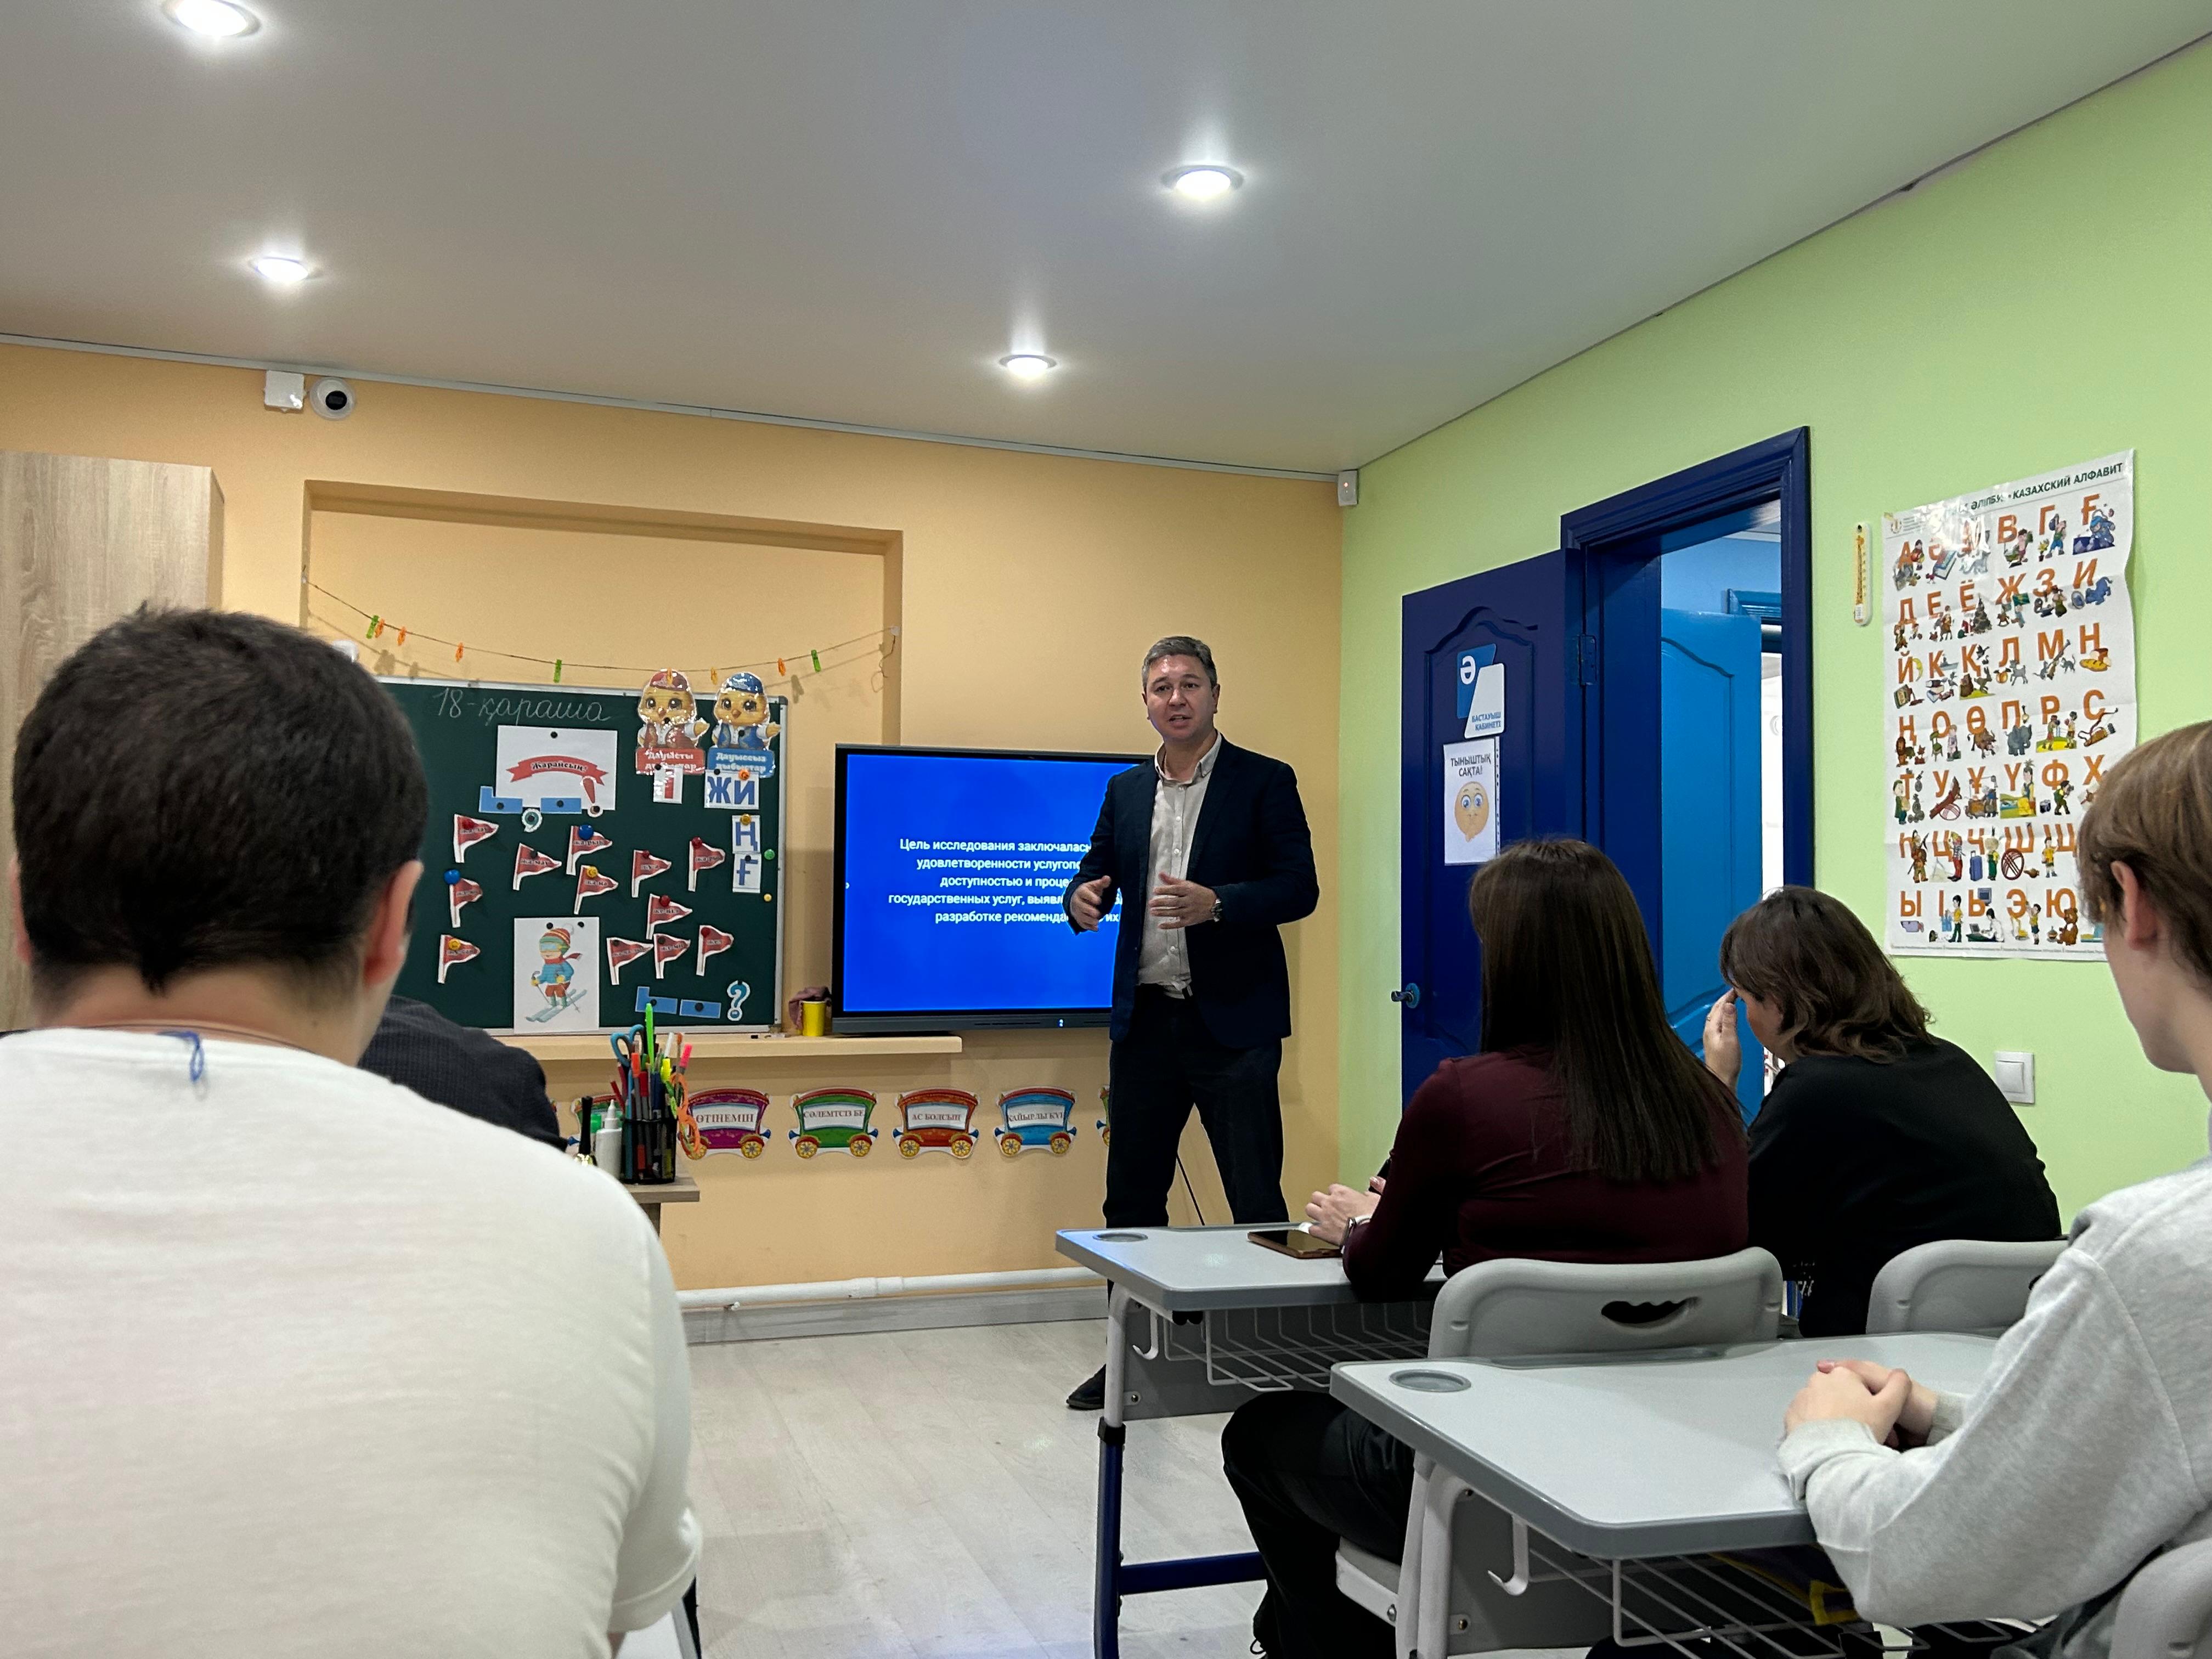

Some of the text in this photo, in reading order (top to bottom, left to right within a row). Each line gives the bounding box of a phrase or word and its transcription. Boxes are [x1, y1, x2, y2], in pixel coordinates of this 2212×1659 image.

[2013, 475, 2071, 499] КАЗАХСКИЙ
[2073, 462, 2123, 484] АЛФАВИТ
[1997, 515, 2018, 544] В
[2039, 505, 2055, 535] Г
[1899, 558, 2098, 624] Д Е Ё Ж З И
[1898, 623, 2100, 683] Й К Қ Л М Н
[1932, 711, 1951, 737] О
[1966, 706, 1985, 735] Ө
[2001, 701, 2020, 729] П
[2041, 696, 2059, 725] Р
[2083, 690, 2106, 720] С
[1451, 753, 1491, 767] ТЫНЫШТЫҚ
[1459, 765, 1483, 778] САҚТА!
[1900, 774, 1914, 800] Т
[1933, 770, 1949, 797] У
[2041, 759, 2068, 789] Ф
[2084, 754, 2104, 785] Х
[900, 839, 930, 851] Цель
[933, 842, 1015, 853] исследования
[1933, 831, 1953, 862] Ц
[1968, 828, 1985, 855] Ч
[2005, 826, 2034, 854] Ш
[917, 859, 1030, 870] удовлетворенности
[940, 877, 1023, 888] доступностью
[1035, 879, 1070, 889] проце
[888, 895, 990, 906] государственных
[992, 896, 1025, 907] услуг,
[1900, 891, 1922, 917] Ы
[1968, 889, 1986, 917] Ь
[2006, 889, 2027, 917] Э
[2046, 888, 2076, 918] Ю
[935, 912, 1002, 923] разработке
[1004, 913, 1068, 923] рекоменда
